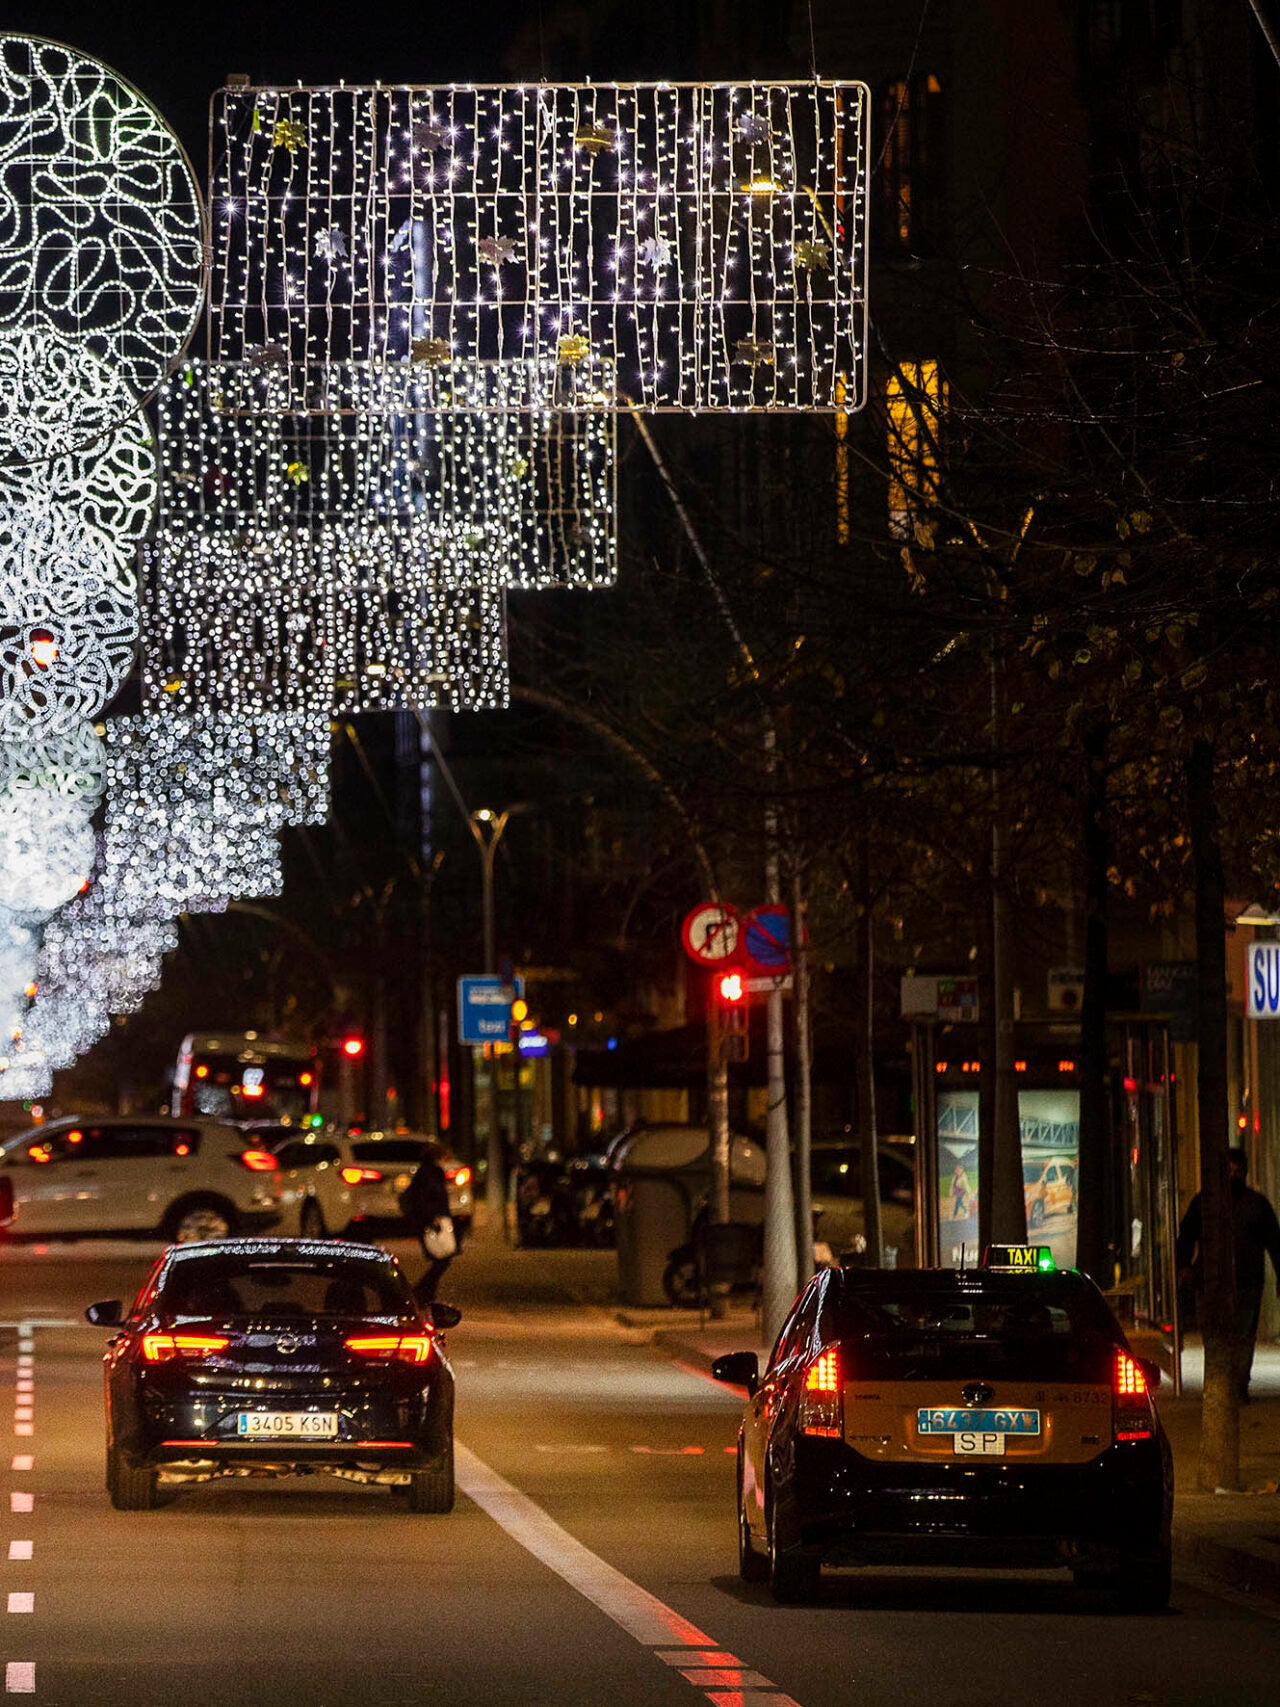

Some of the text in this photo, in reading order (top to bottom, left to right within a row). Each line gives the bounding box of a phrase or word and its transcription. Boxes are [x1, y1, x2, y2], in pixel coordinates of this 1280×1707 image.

[1007, 1248, 1038, 1266] TAXI
[252, 1416, 333, 1432] 3405 KSN
[961, 1433, 998, 1452] SP
